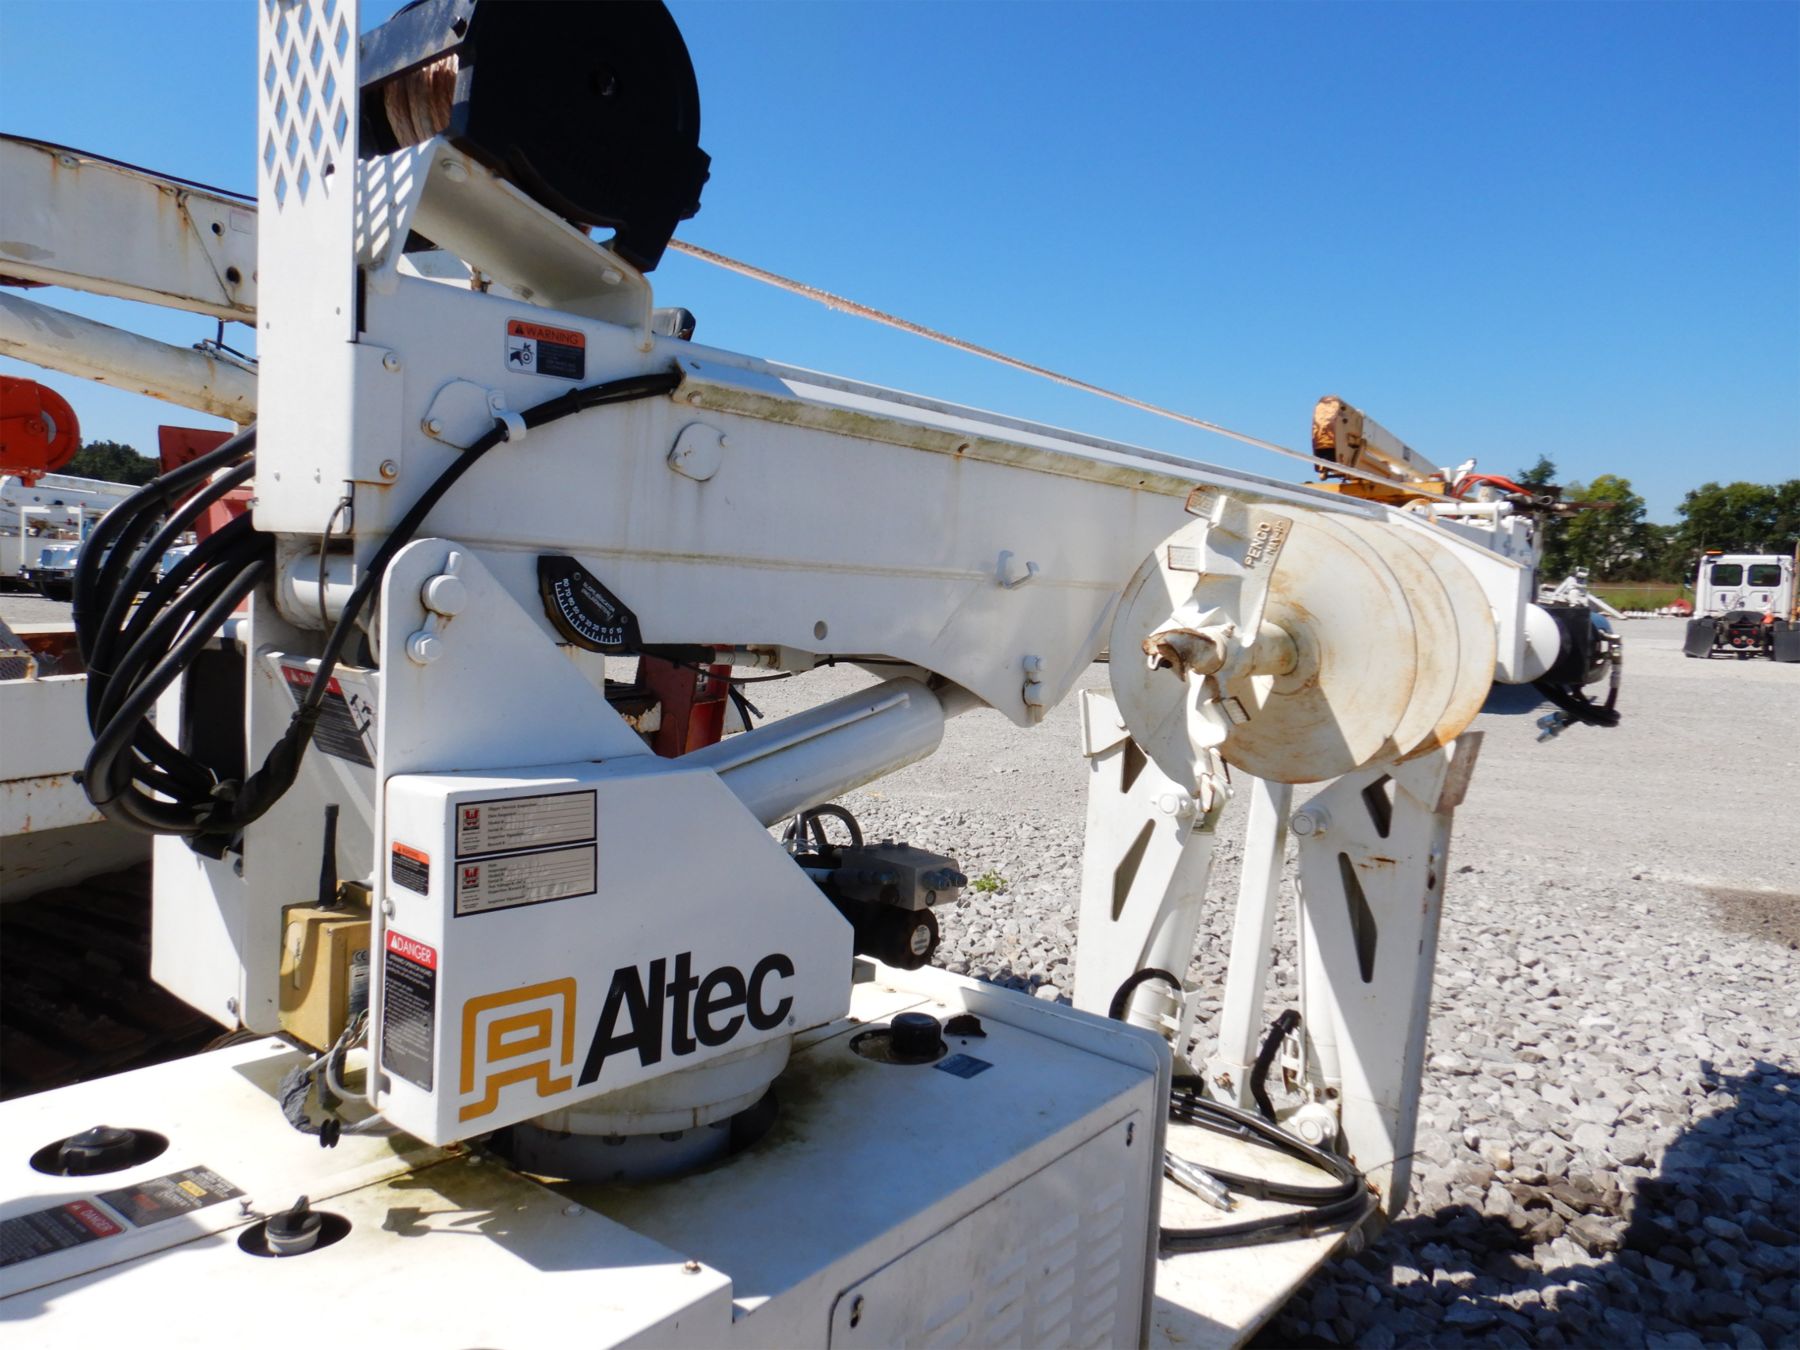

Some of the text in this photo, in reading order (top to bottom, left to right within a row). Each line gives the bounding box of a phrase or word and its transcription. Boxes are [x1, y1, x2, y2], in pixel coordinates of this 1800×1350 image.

[525, 326, 579, 345] WARNING
[1244, 521, 1272, 570] PENGO
[564, 588, 572, 597] 70
[397, 936, 432, 964] DANGER
[577, 951, 795, 1087] Altec
[80, 1208, 114, 1232] DANGER
